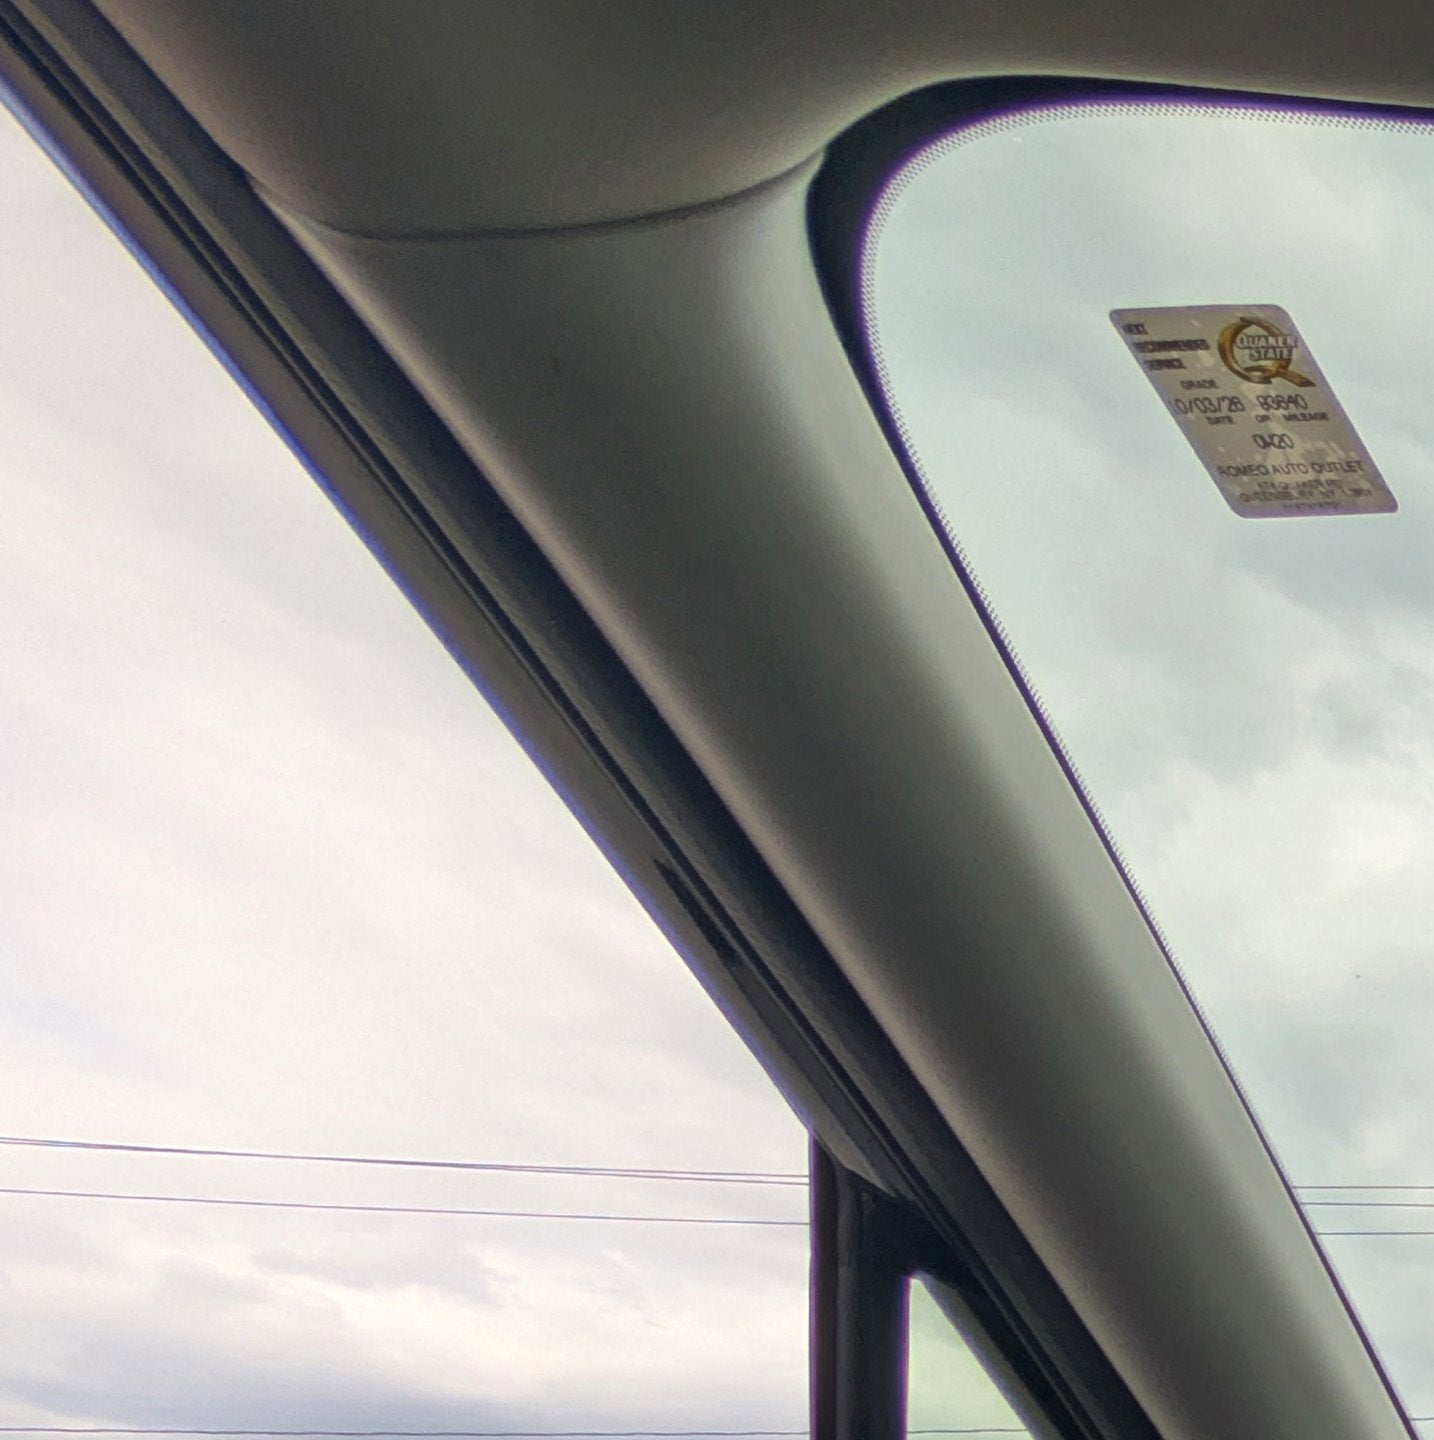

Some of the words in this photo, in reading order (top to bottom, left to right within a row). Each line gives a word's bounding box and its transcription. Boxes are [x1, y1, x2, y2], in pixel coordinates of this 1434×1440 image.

[1235, 334, 1298, 348] QUAKER
[1249, 348, 1293, 361] STATE
[1217, 465, 1270, 477] ROMEO
[1271, 462, 1309, 475] AUTO
[1312, 460, 1364, 473] OUTLET
